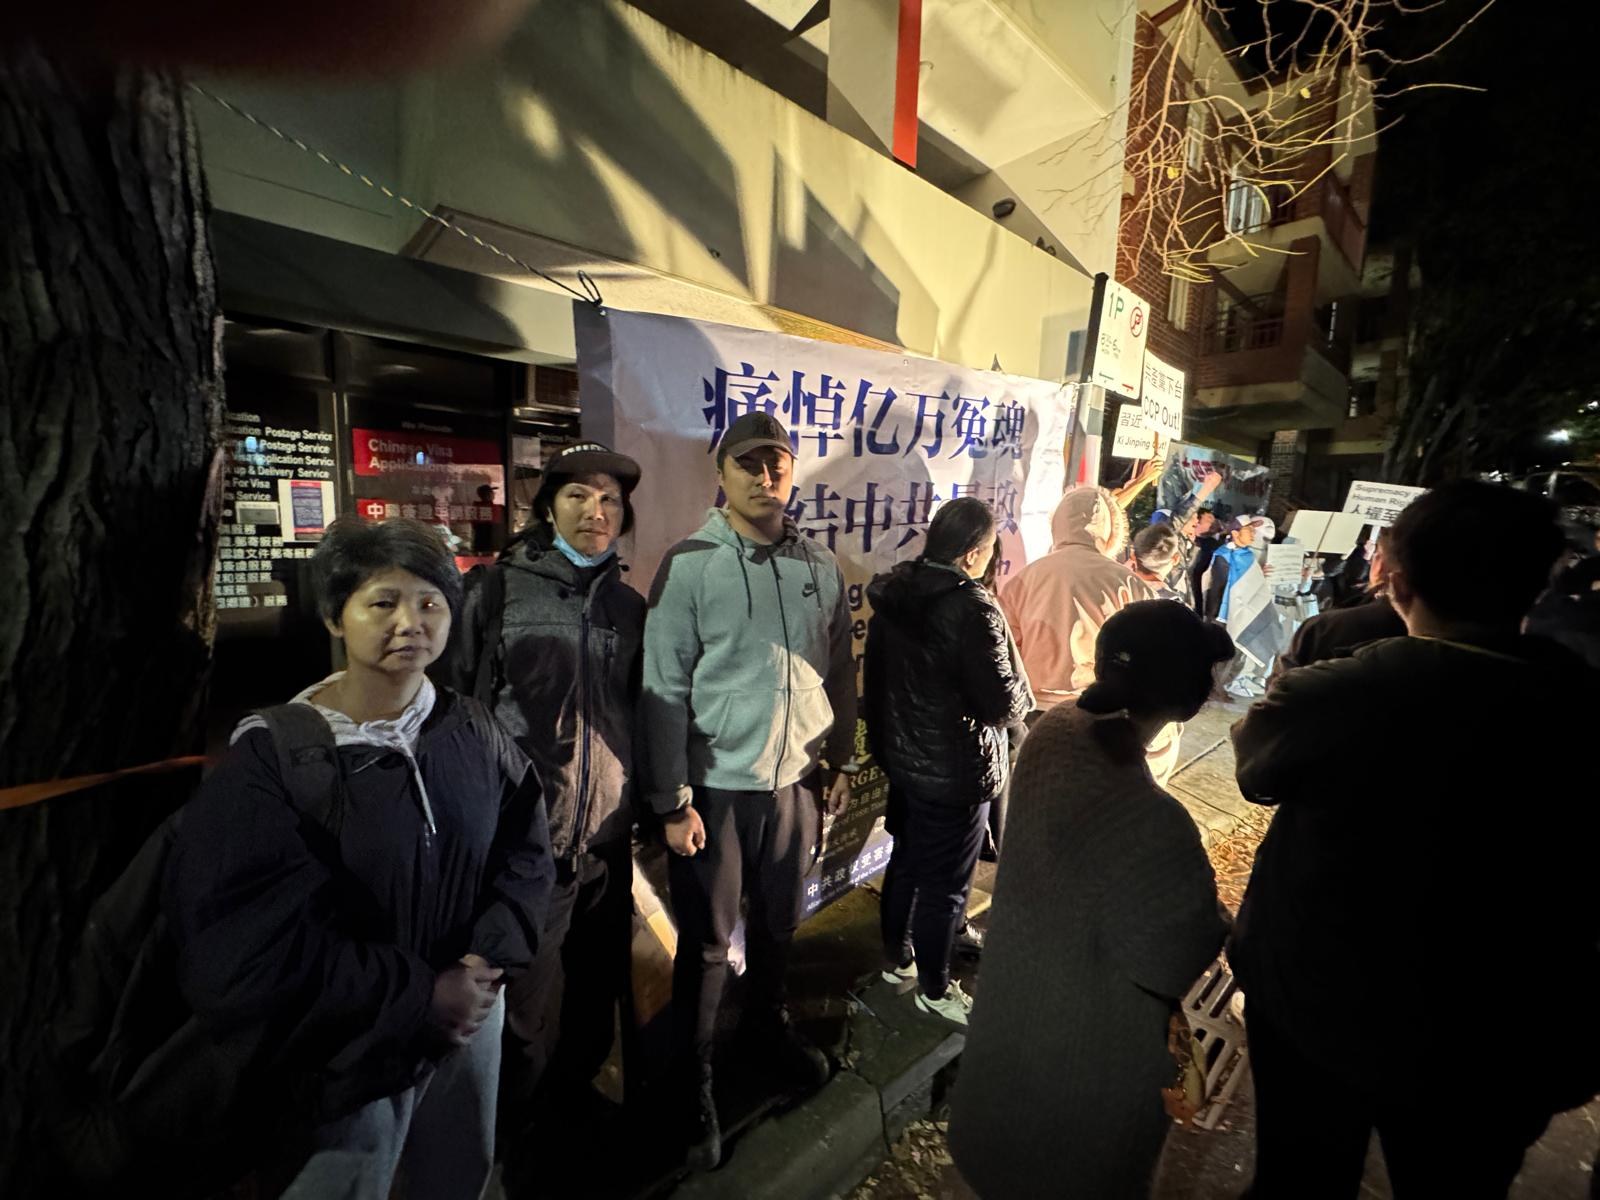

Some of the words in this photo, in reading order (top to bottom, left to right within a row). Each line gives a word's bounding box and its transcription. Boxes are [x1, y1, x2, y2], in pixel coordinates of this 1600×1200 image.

[1108, 292, 1125, 320] 1P
[702, 361, 1026, 460] 痛悼亿万冤魂
[1144, 395, 1160, 421] CCP
[1161, 406, 1181, 431] Out!
[264, 426, 301, 441] Postage
[259, 439, 297, 454] Postage
[298, 441, 331, 454] Service
[425, 442, 453, 458] Visa
[1125, 437, 1151, 450] Jinping
[257, 466, 294, 479] Delivery
[297, 467, 330, 479] Service
[232, 478, 249, 488] For
[249, 478, 271, 489] Visa
[236, 491, 272, 501] Service
[1351, 493, 1387, 503] Human
